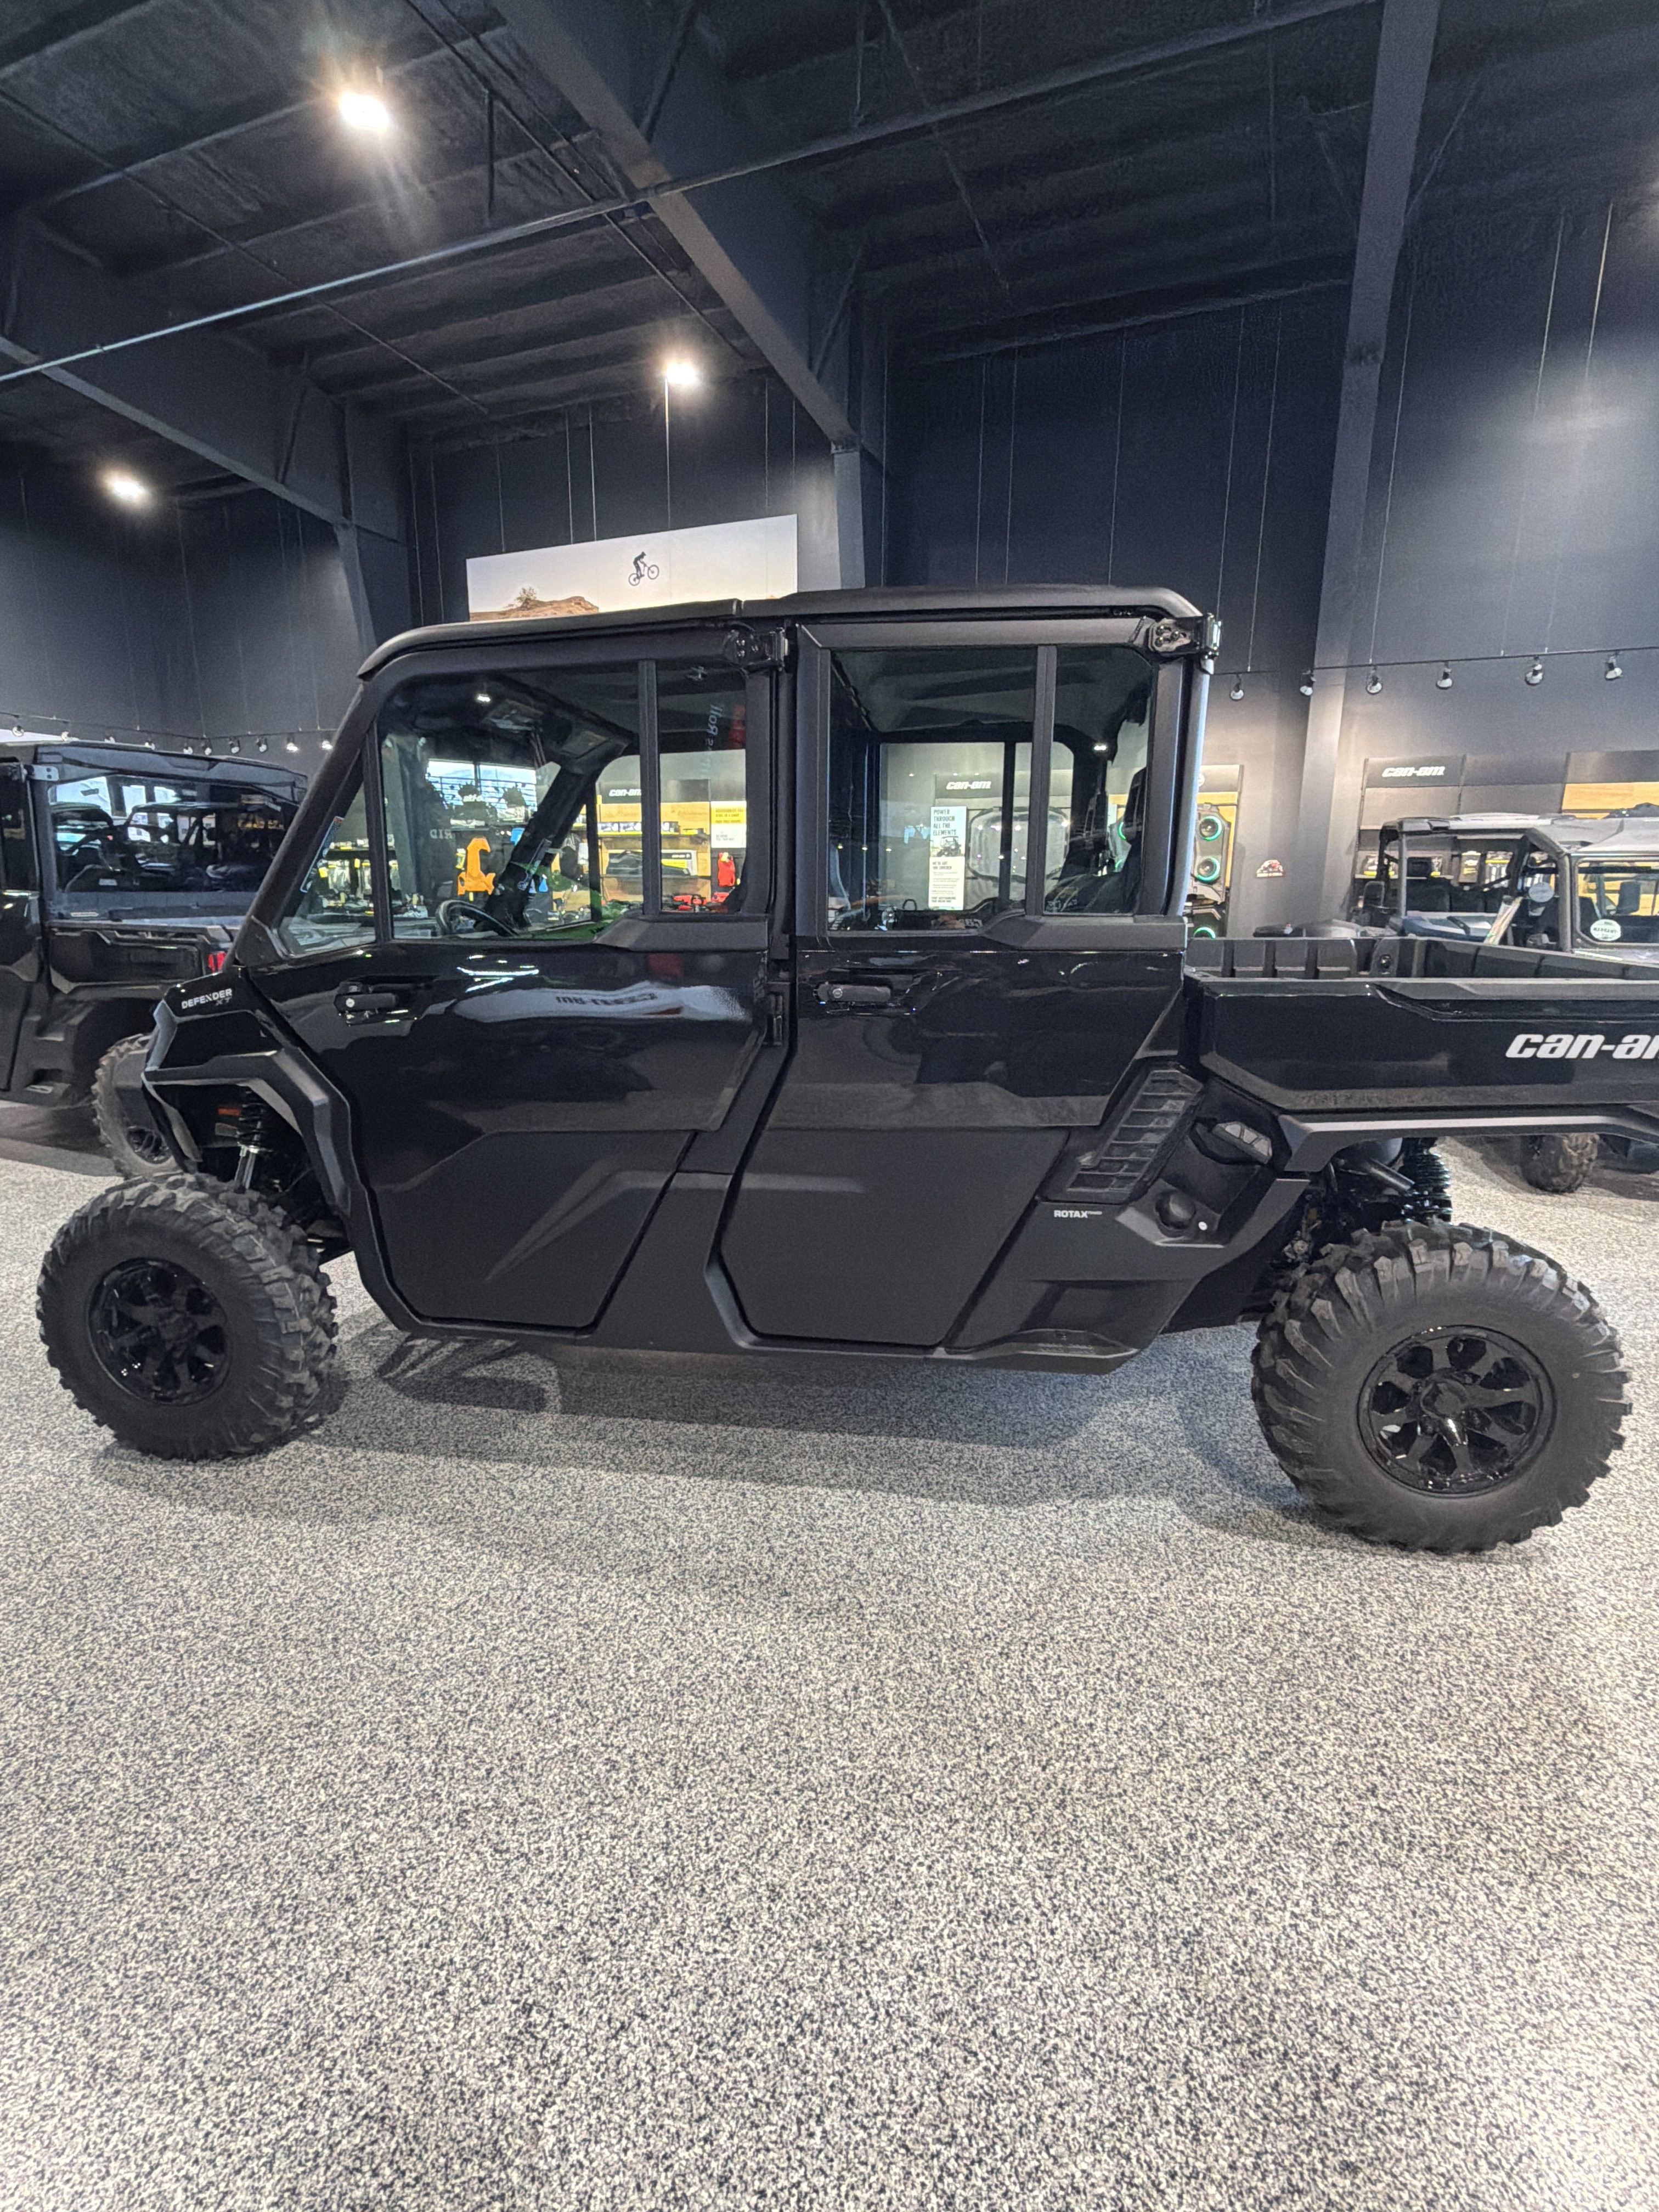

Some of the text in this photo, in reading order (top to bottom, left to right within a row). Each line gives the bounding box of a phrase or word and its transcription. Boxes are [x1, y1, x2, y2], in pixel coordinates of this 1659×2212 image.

[1381, 766, 1446, 777] can-am
[946, 781, 991, 790] can-am
[181, 988, 233, 1009] DEFENDER
[1054, 1210, 1088, 1218] ROTAX
